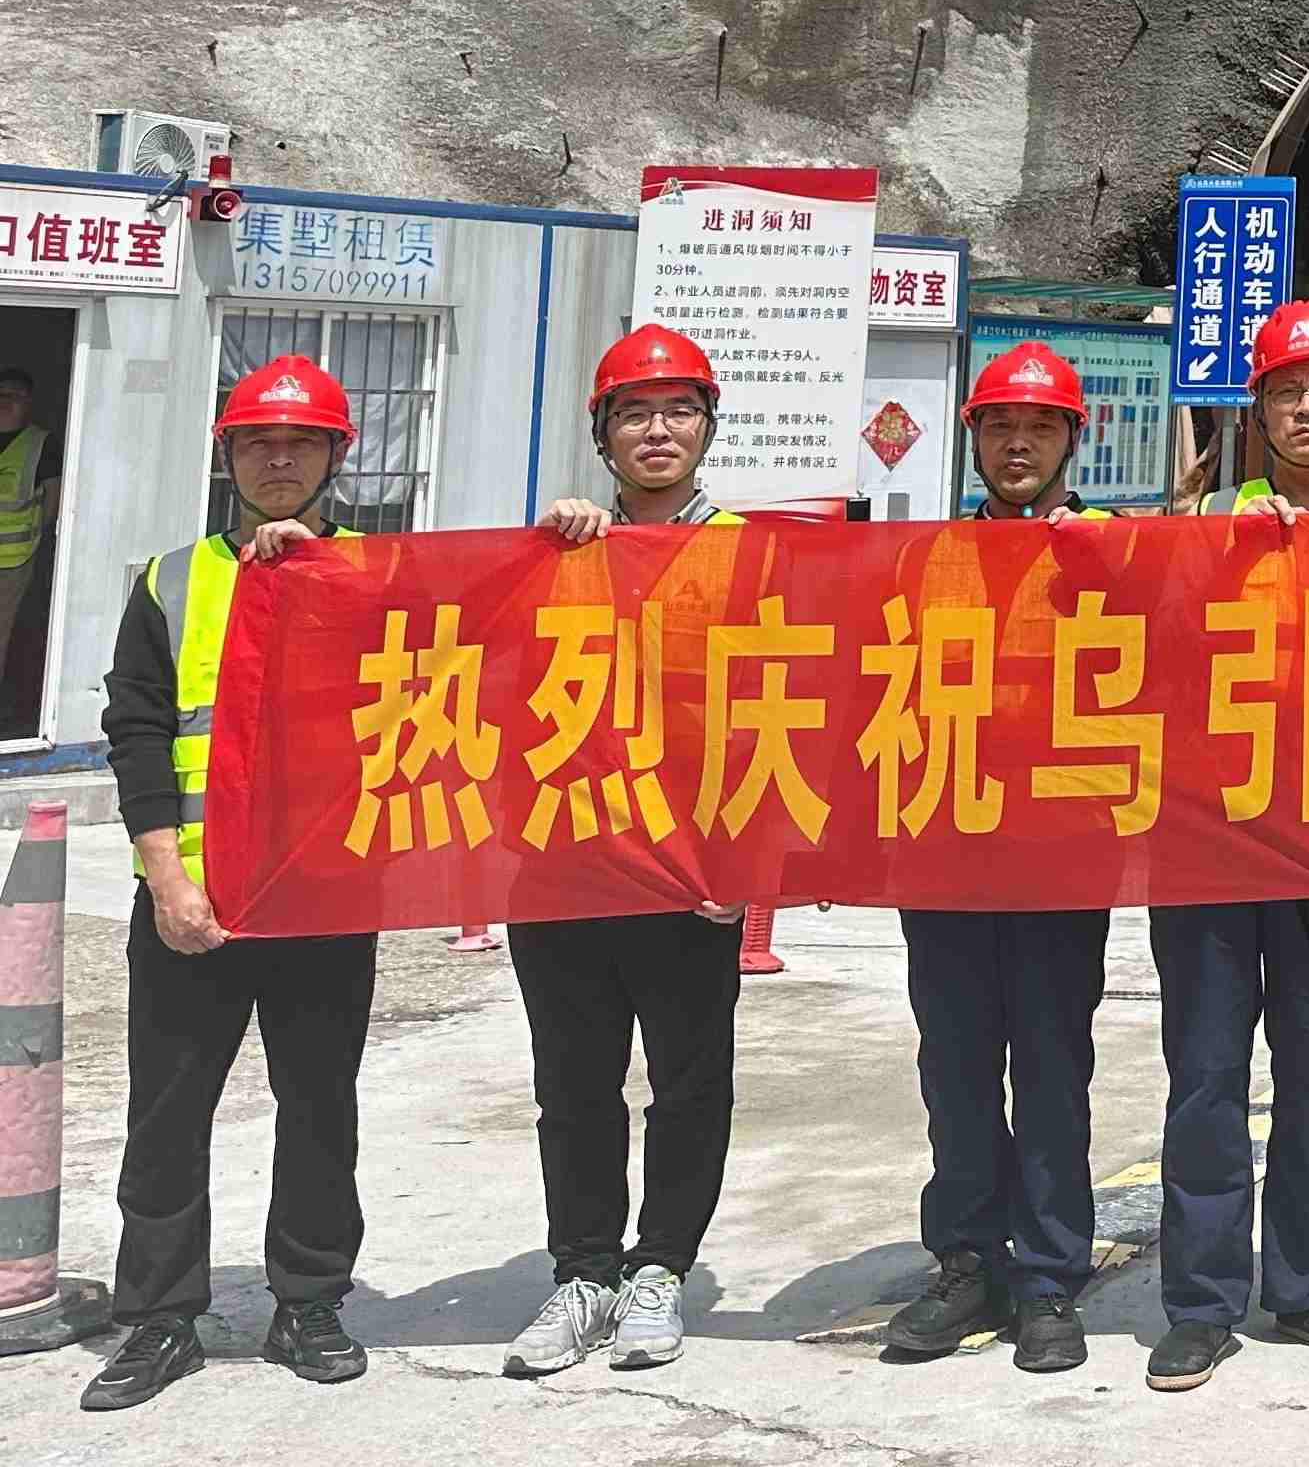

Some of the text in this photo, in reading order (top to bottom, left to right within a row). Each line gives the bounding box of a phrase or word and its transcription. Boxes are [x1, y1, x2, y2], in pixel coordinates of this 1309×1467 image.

[236, 210, 434, 268] 集墅租赁
[701, 208, 813, 232] 进洞须知
[241, 261, 427, 301] 13157099911
[870, 267, 947, 306] 物资室
[1190, 207, 1227, 347] 人行通道
[1240, 206, 1277, 347] 机动车道
[668, 328, 758, 341] 方可进洞作业。
[702, 349, 821, 362] 洞人数不得大于9人。
